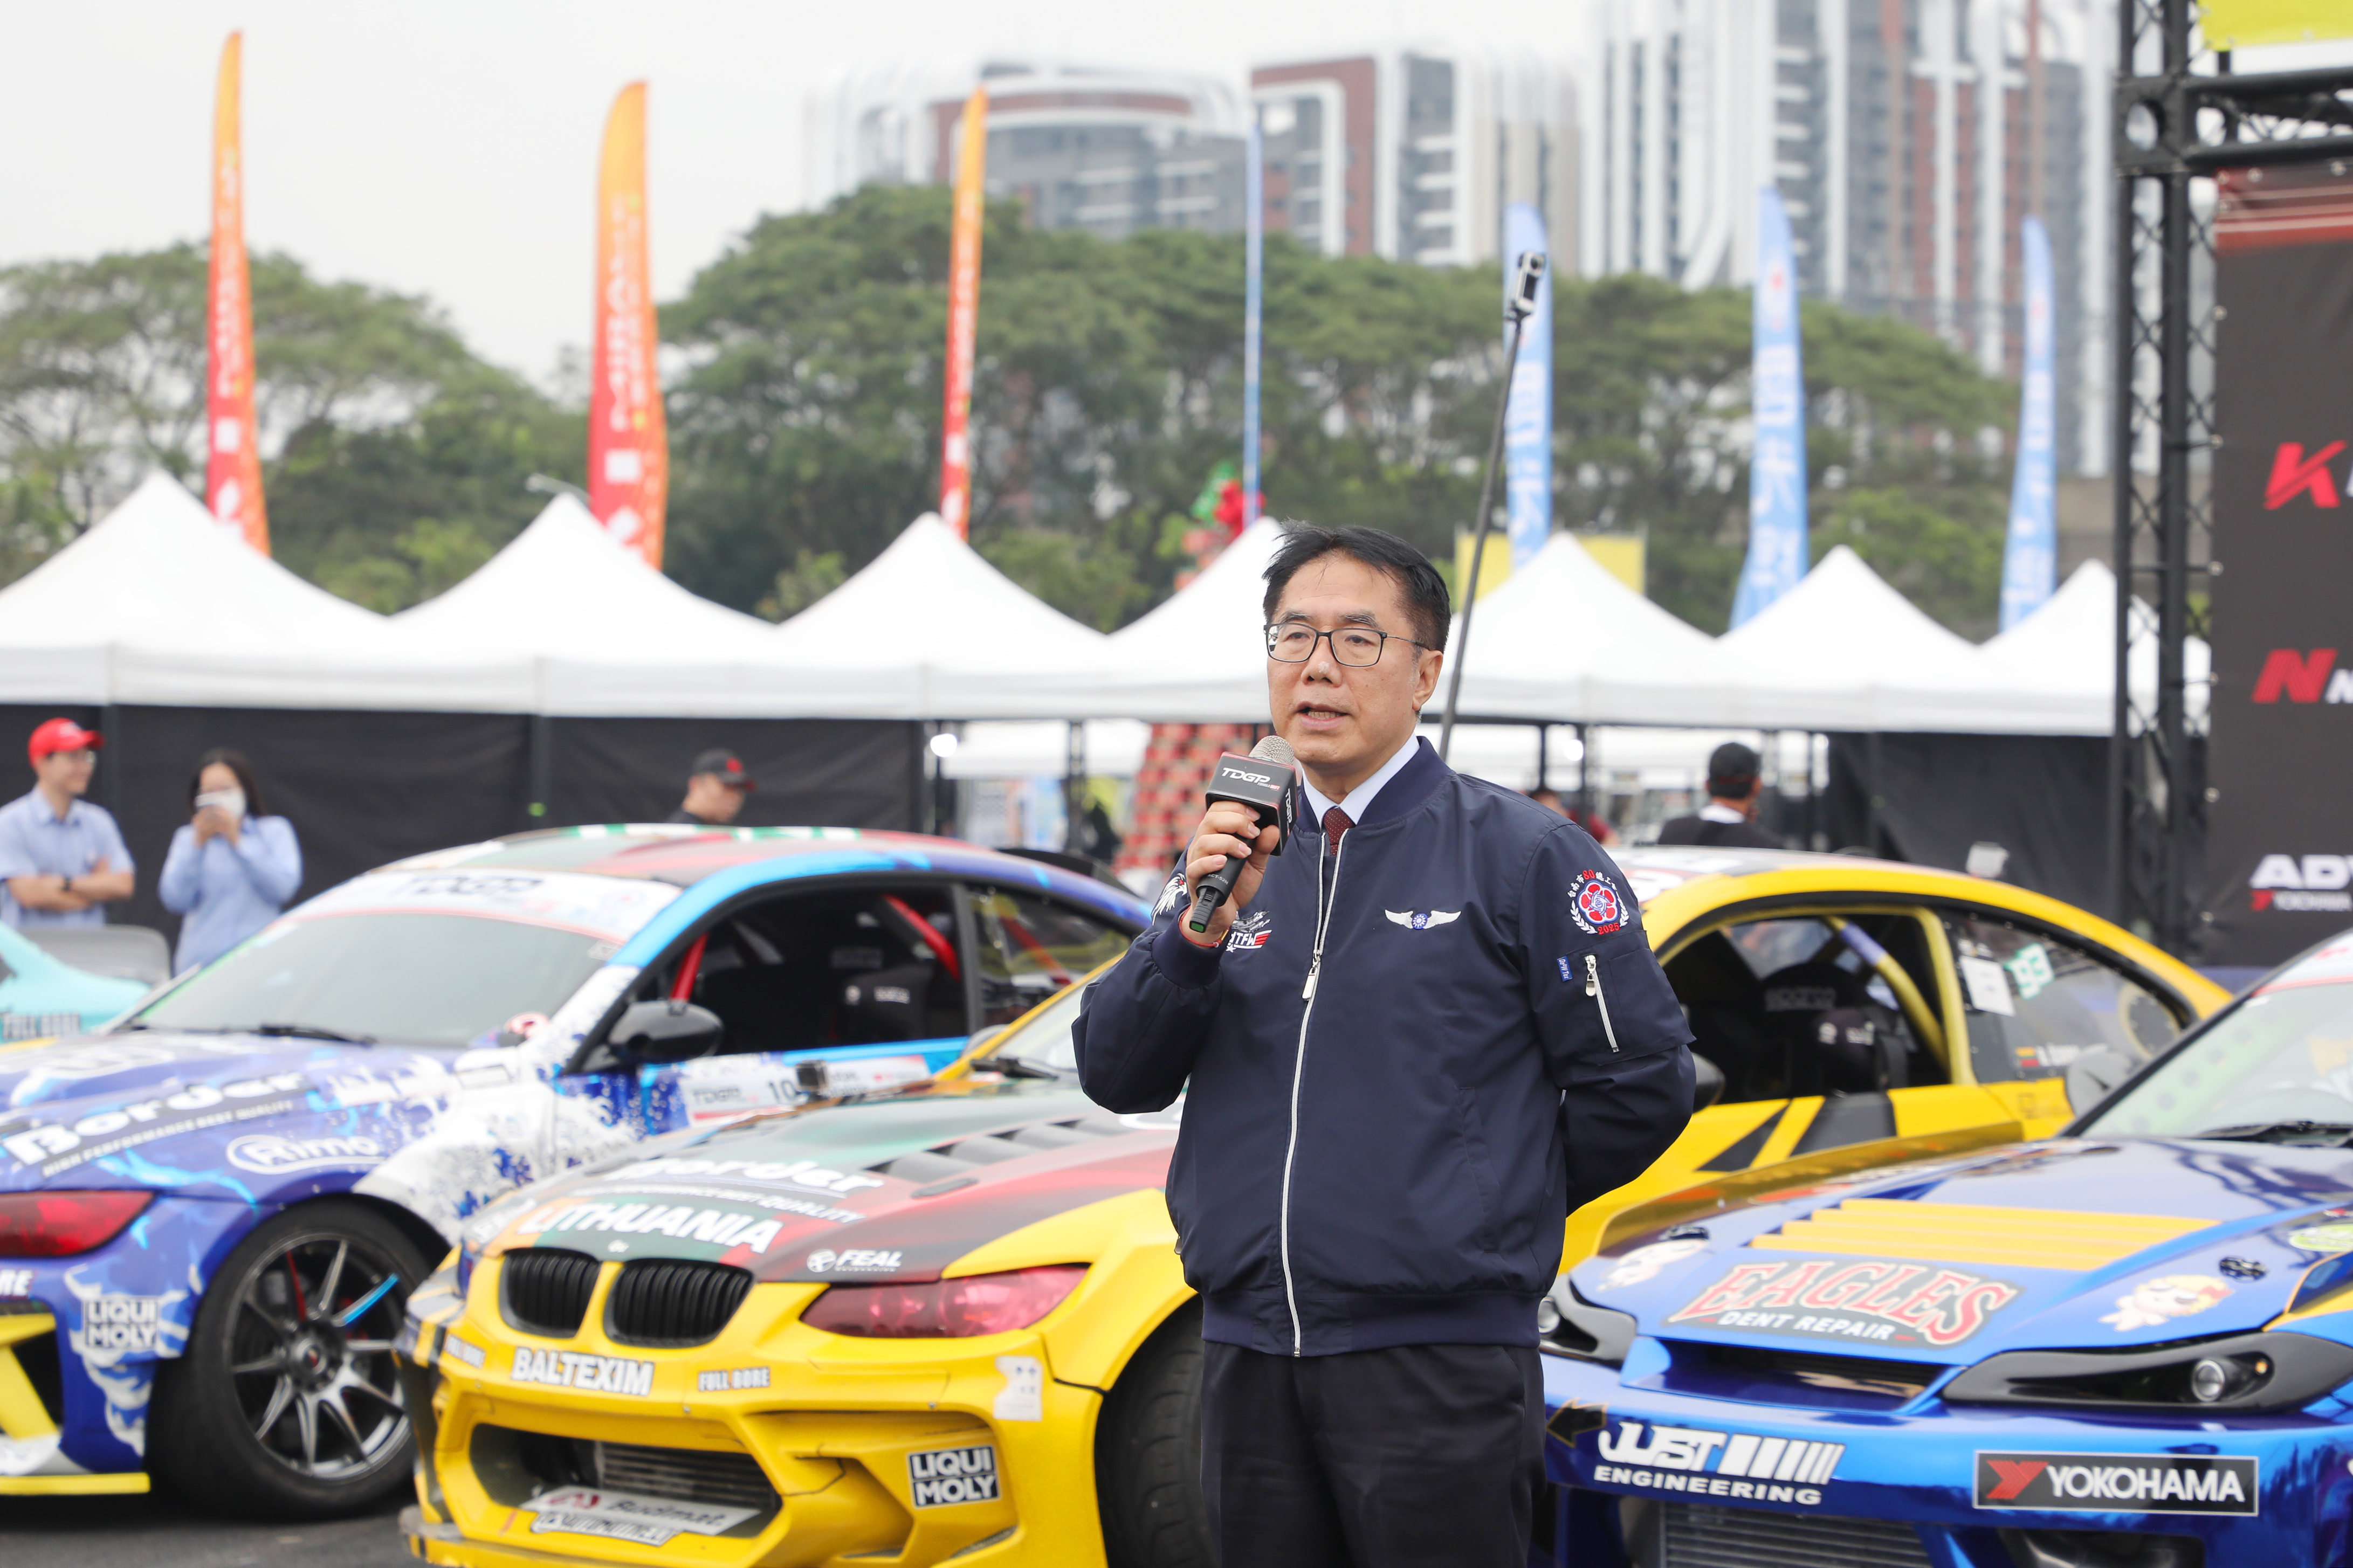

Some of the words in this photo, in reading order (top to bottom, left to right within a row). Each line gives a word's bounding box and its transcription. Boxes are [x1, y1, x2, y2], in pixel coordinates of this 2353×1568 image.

[1222, 768, 1270, 783] TDGP
[1207, 873, 1229, 885] ACT-52H
[2249, 854, 2353, 889] AD
[1598, 923, 1620, 935] 2025
[42, 1153, 83, 1178] HIGH
[83, 1120, 196, 1159] PERFORMANCE
[196, 1109, 233, 1129] BEST
[236, 1099, 294, 1120] QUALITY
[760, 1194, 866, 1223] QUALITY
[517, 1202, 784, 1254] LITHUANIA
[837, 1249, 903, 1268] FEAL
[88, 1299, 157, 1324] LIQUI
[1668, 1260, 2018, 1345] EAGLES
[88, 1324, 157, 1348] MOLY
[1718, 1310, 1793, 1332] DENT
[1794, 1316, 1896, 1341] REPAIR
[511, 1348, 655, 1396] BALTEXIM
[698, 1371, 730, 1392] FULL
[732, 1367, 770, 1389] BORE
[1598, 1421, 1727, 1472] JUST
[912, 1448, 993, 1479] LIQUI
[916, 1475, 996, 1507] MOLY
[1593, 1465, 1822, 1505] ENGINEERING
[2046, 1465, 2245, 1502] YOKOHAMA
